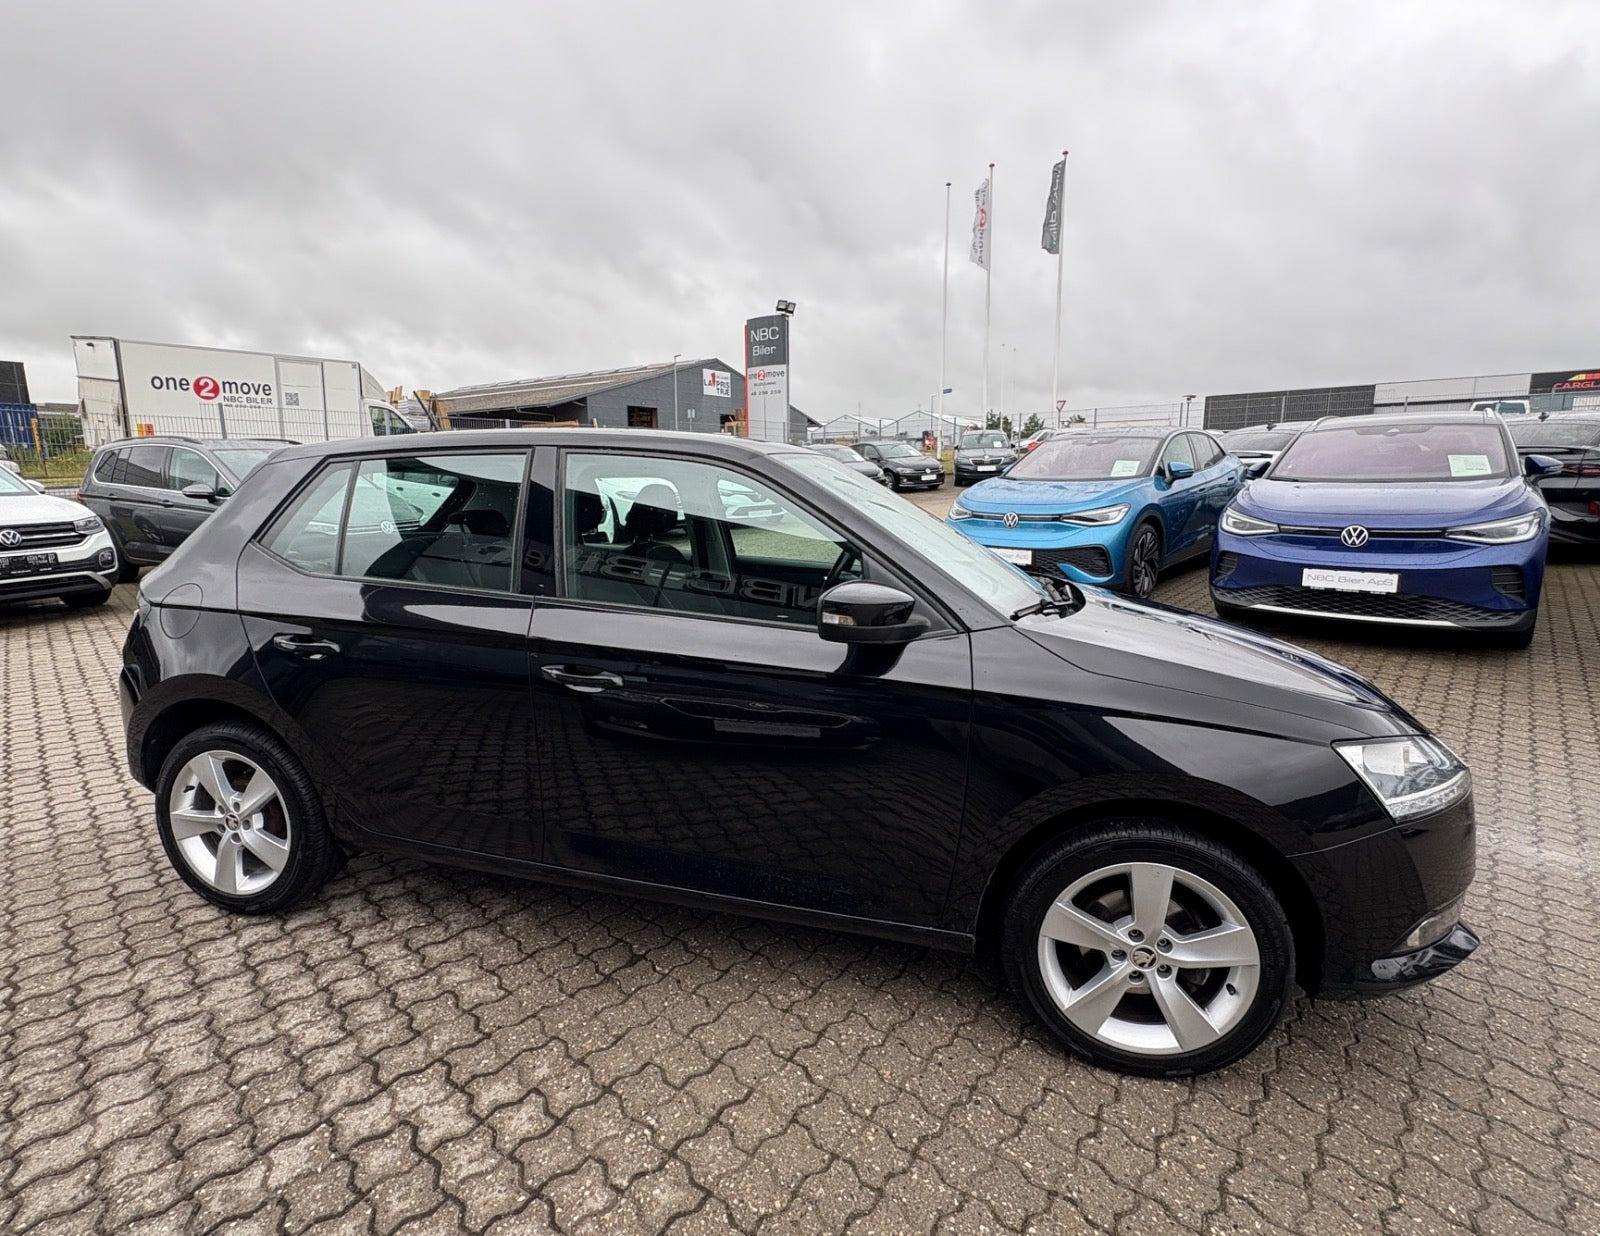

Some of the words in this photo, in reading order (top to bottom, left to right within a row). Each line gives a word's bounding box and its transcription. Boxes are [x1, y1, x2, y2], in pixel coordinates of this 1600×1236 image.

[750, 326, 780, 342] NBC
[752, 344, 777, 356] Biler
[1552, 380, 1600, 390] CARGL
[223, 395, 244, 404] NBC
[246, 396, 273, 405] BILER
[1306, 574, 1334, 583] NBC
[1337, 576, 1365, 584] Biler
[1367, 578, 1394, 587] ApS
